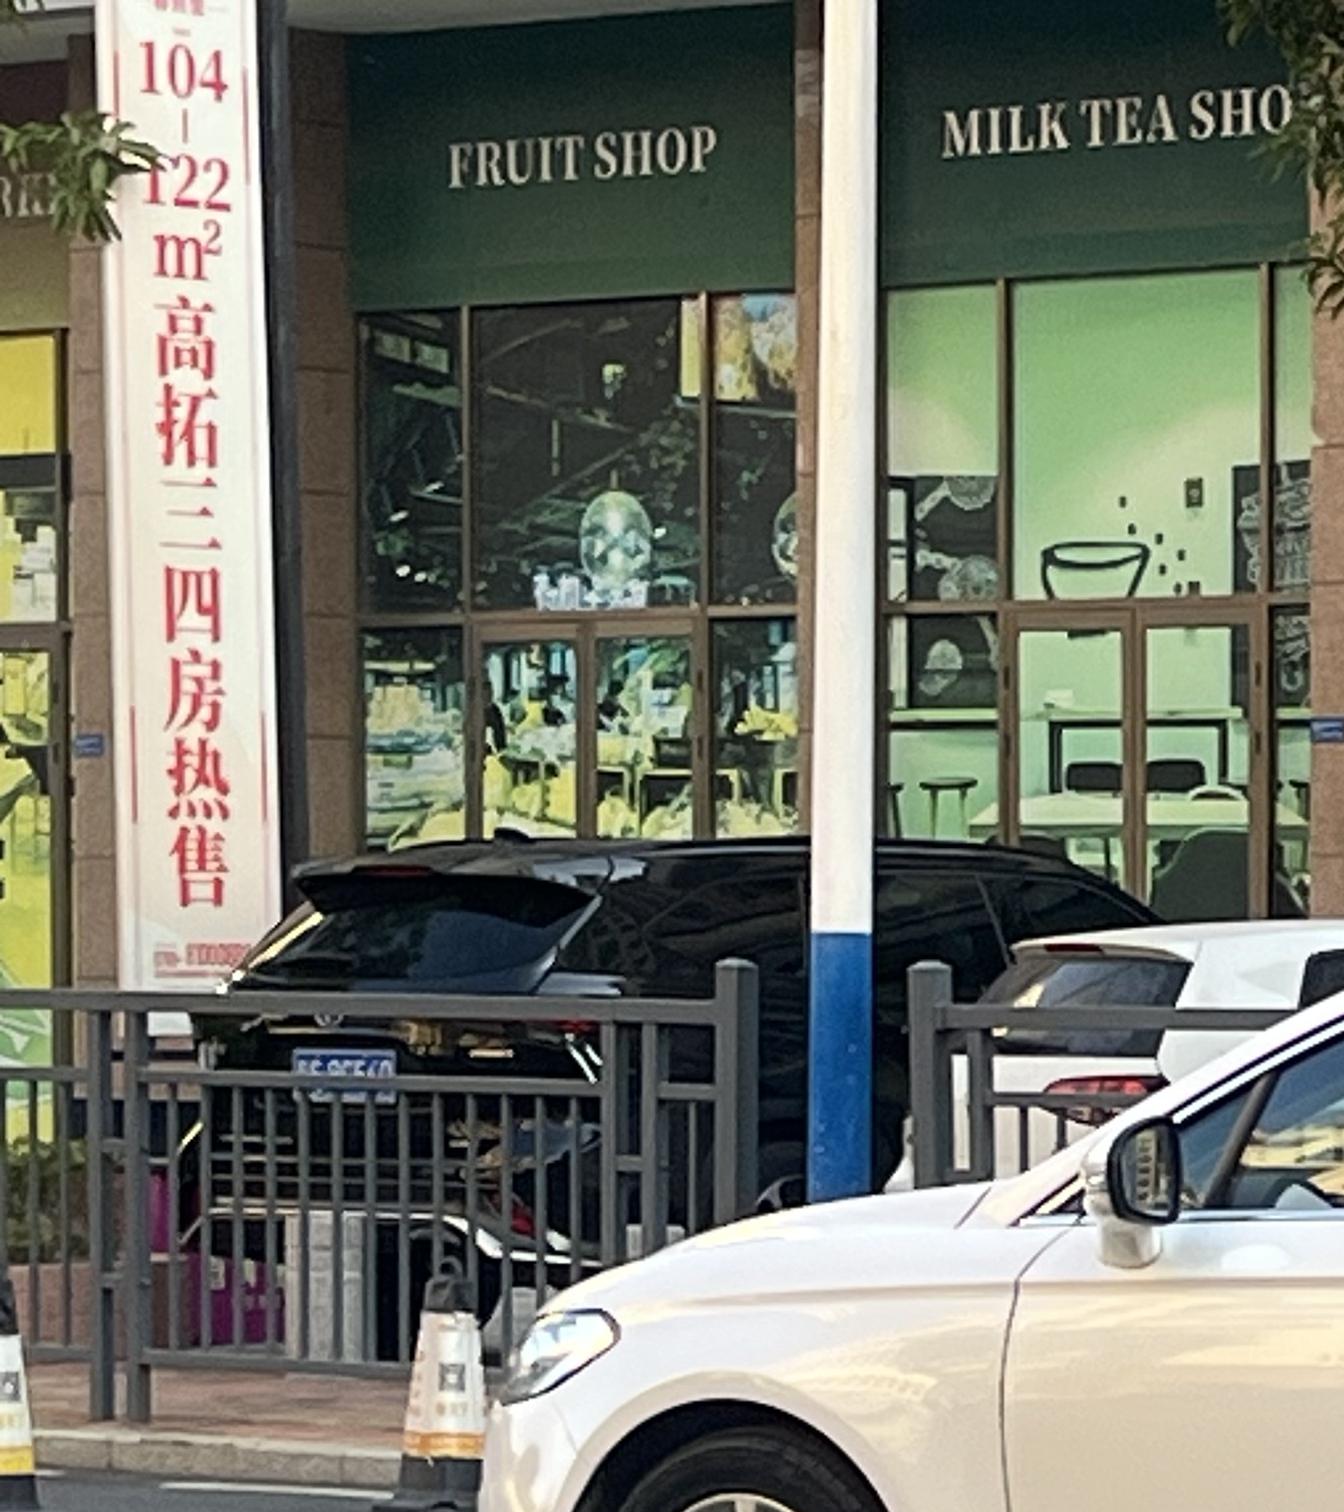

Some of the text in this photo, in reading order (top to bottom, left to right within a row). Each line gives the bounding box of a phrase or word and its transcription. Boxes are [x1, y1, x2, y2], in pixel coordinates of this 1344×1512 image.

[139, 40, 229, 102] 104
[941, 84, 1293, 159] MILK TEA SHO
[143, 153, 231, 212] 122
[448, 125, 717, 189] FRUIT SHOP
